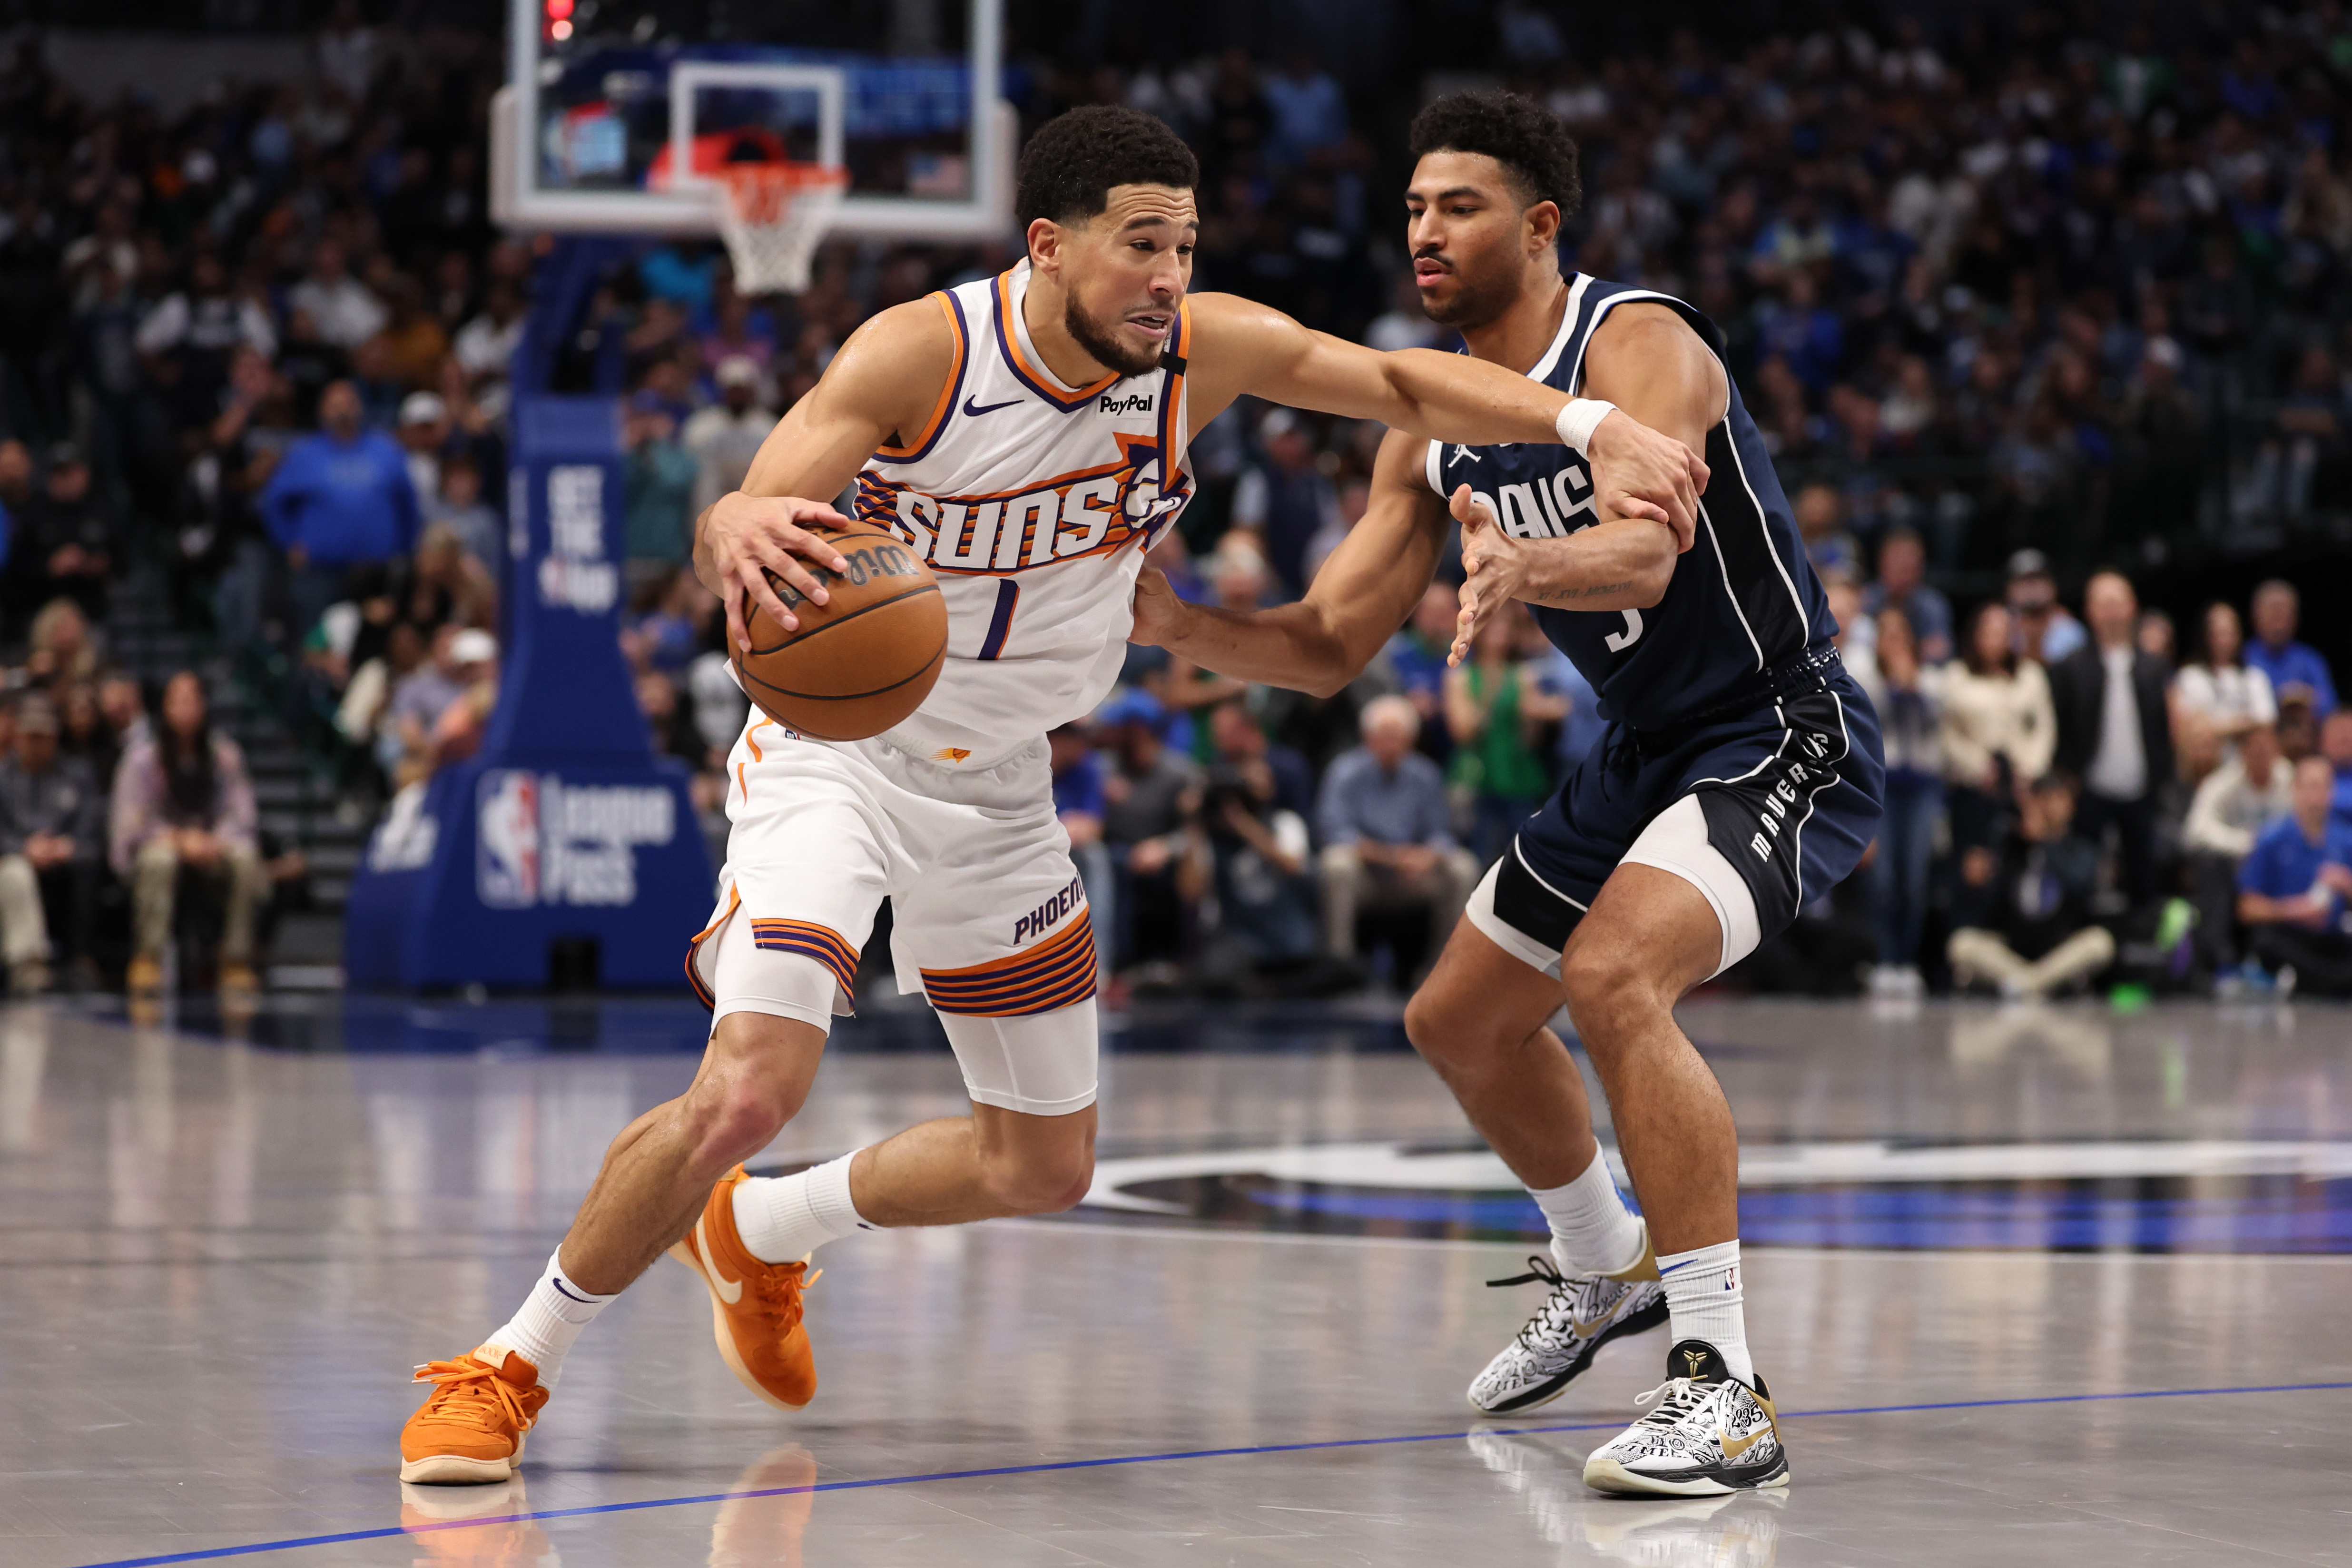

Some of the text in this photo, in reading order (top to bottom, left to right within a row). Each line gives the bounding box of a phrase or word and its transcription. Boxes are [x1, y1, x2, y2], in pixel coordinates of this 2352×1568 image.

[1100, 394, 1153, 416] PayPal
[890, 476, 1118, 569] SUNS
[977, 578, 1020, 661] 1
[1014, 870, 1083, 946] PHOENI
